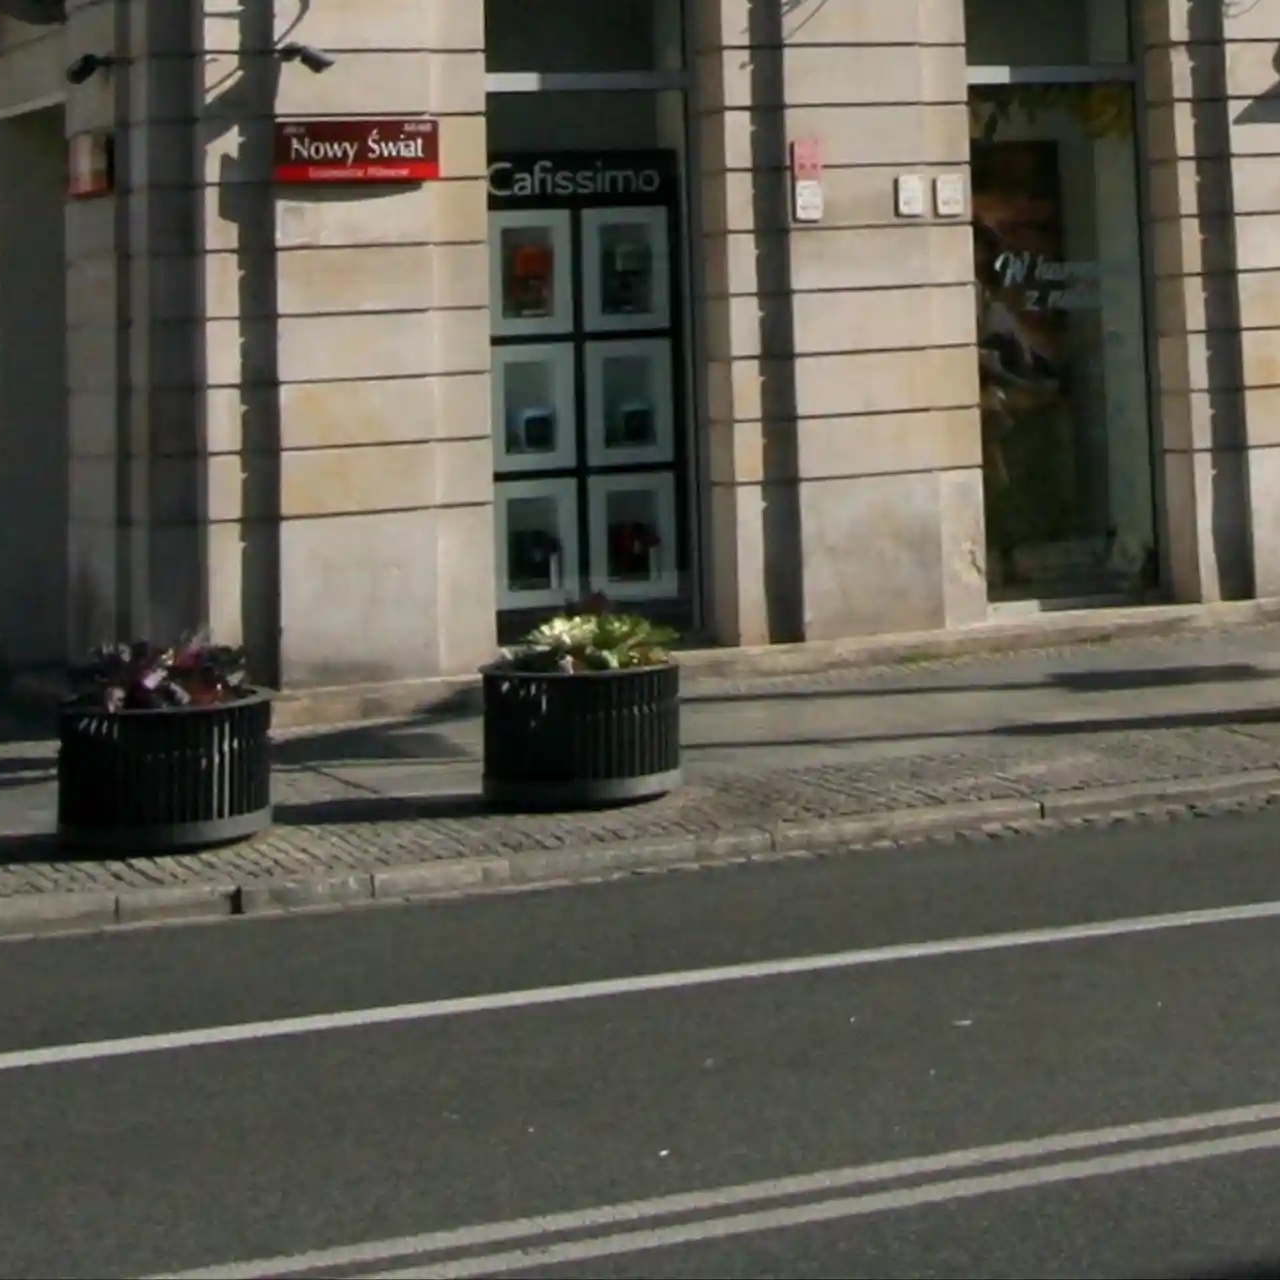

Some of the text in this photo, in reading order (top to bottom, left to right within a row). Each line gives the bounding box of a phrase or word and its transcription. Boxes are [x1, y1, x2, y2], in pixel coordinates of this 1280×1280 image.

[290, 127, 425, 168] Nowy Świat
[488, 159, 661, 196] Cafissimo
